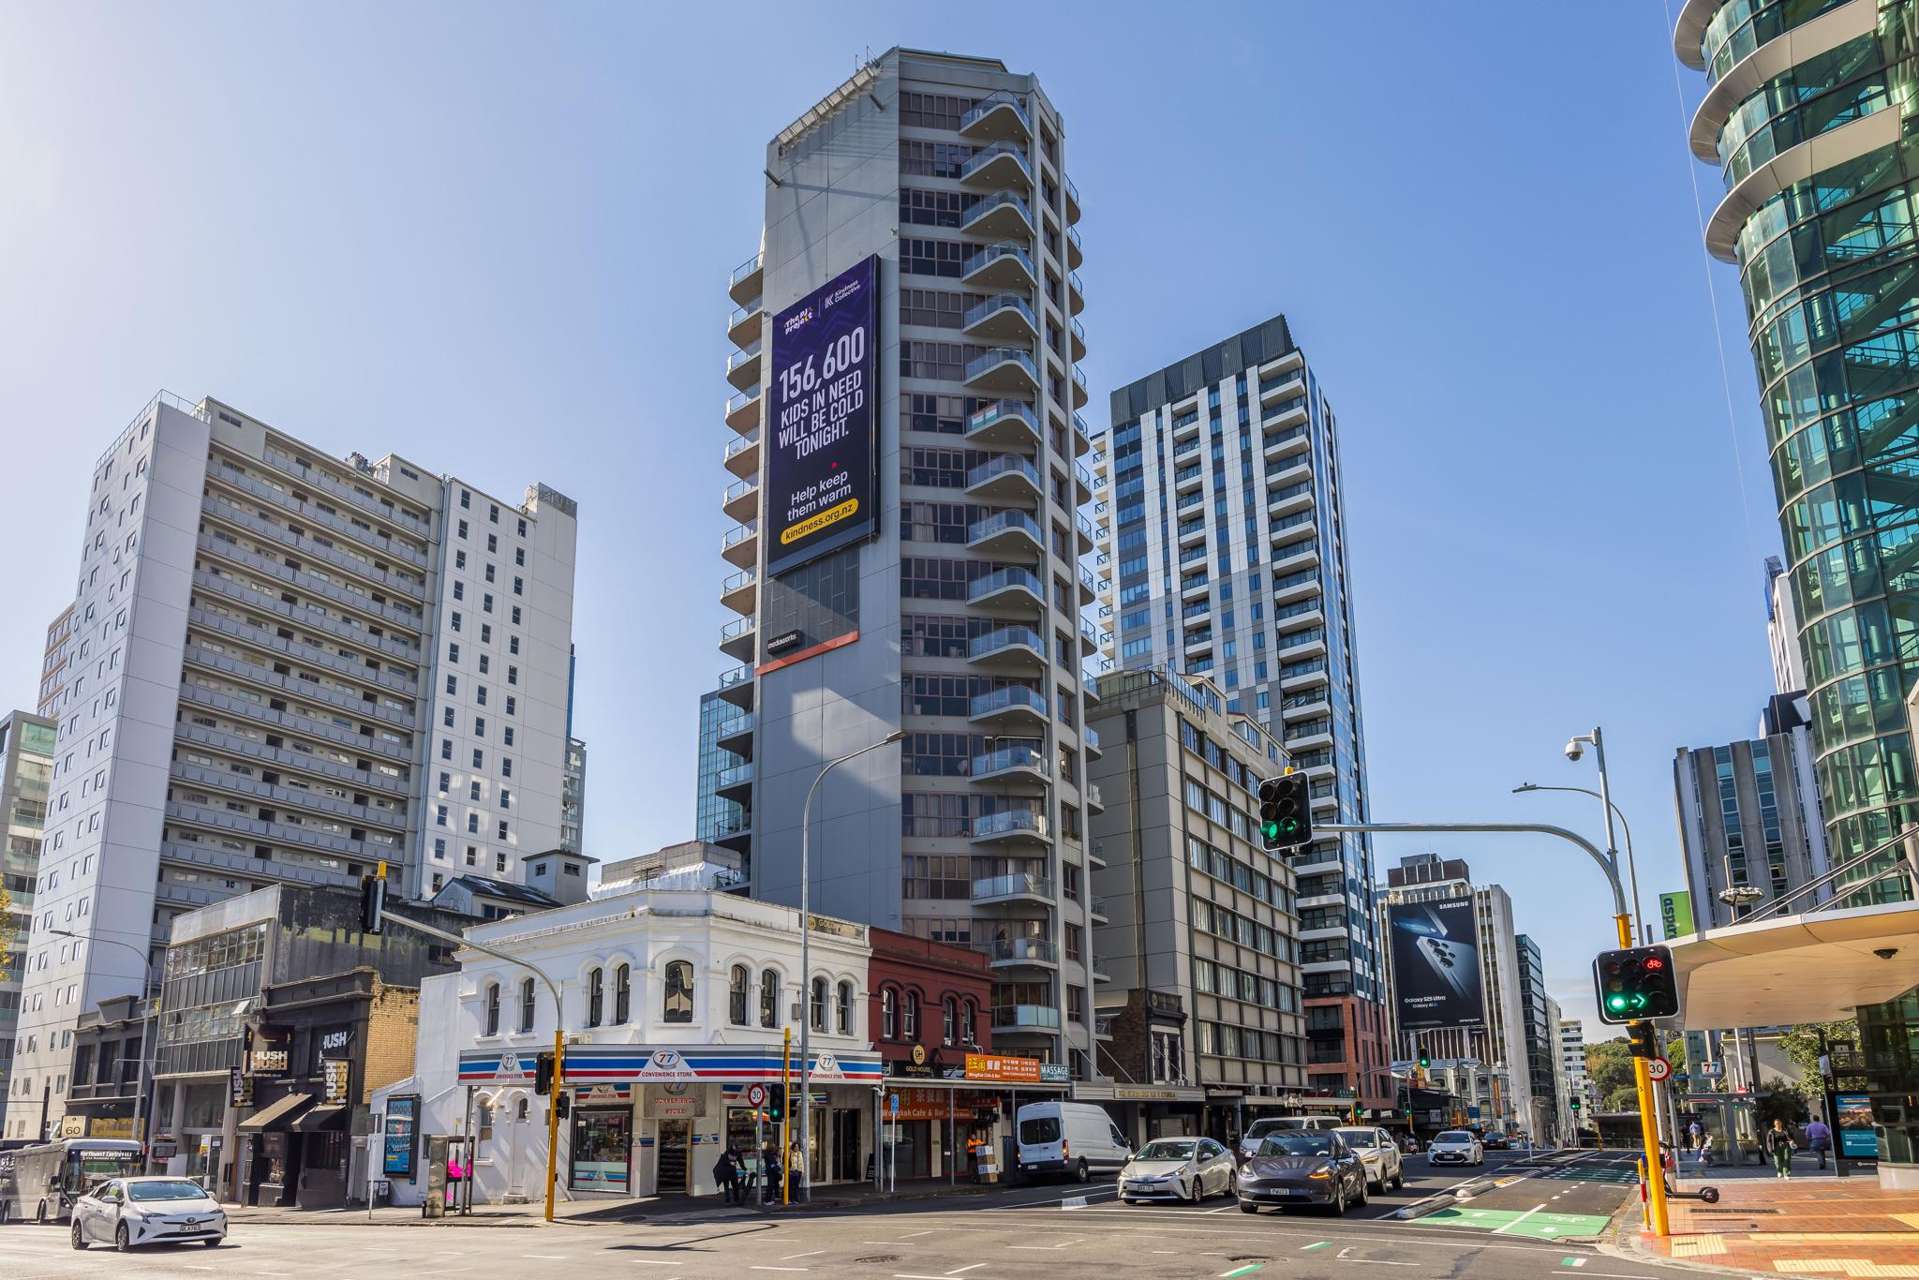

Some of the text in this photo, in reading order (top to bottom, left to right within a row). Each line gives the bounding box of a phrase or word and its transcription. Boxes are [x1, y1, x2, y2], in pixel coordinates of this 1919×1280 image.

[779, 326, 865, 404] 156,600
[781, 369, 862, 429] KIDS IN NEED
[779, 389, 864, 449] WILL BE COLD
[795, 417, 849, 460] TONIGHT.
[791, 471, 848, 505] Help keep
[787, 484, 851, 521] them warm
[785, 503, 853, 540] kindness.org.nz
[1439, 901, 1469, 909] SAMSUNG
[505, 1056, 514, 1066] 77
[660, 1054, 674, 1063] 77
[822, 1057, 832, 1065] 77
[1041, 1065, 1068, 1075] MASSAGE
[1650, 1064, 1664, 1074] 30
[1703, 1064, 1718, 1073] 77
[325, 1061, 337, 1104] HUSH
[752, 1090, 762, 1100] 30
[65, 1126, 81, 1135] 60
